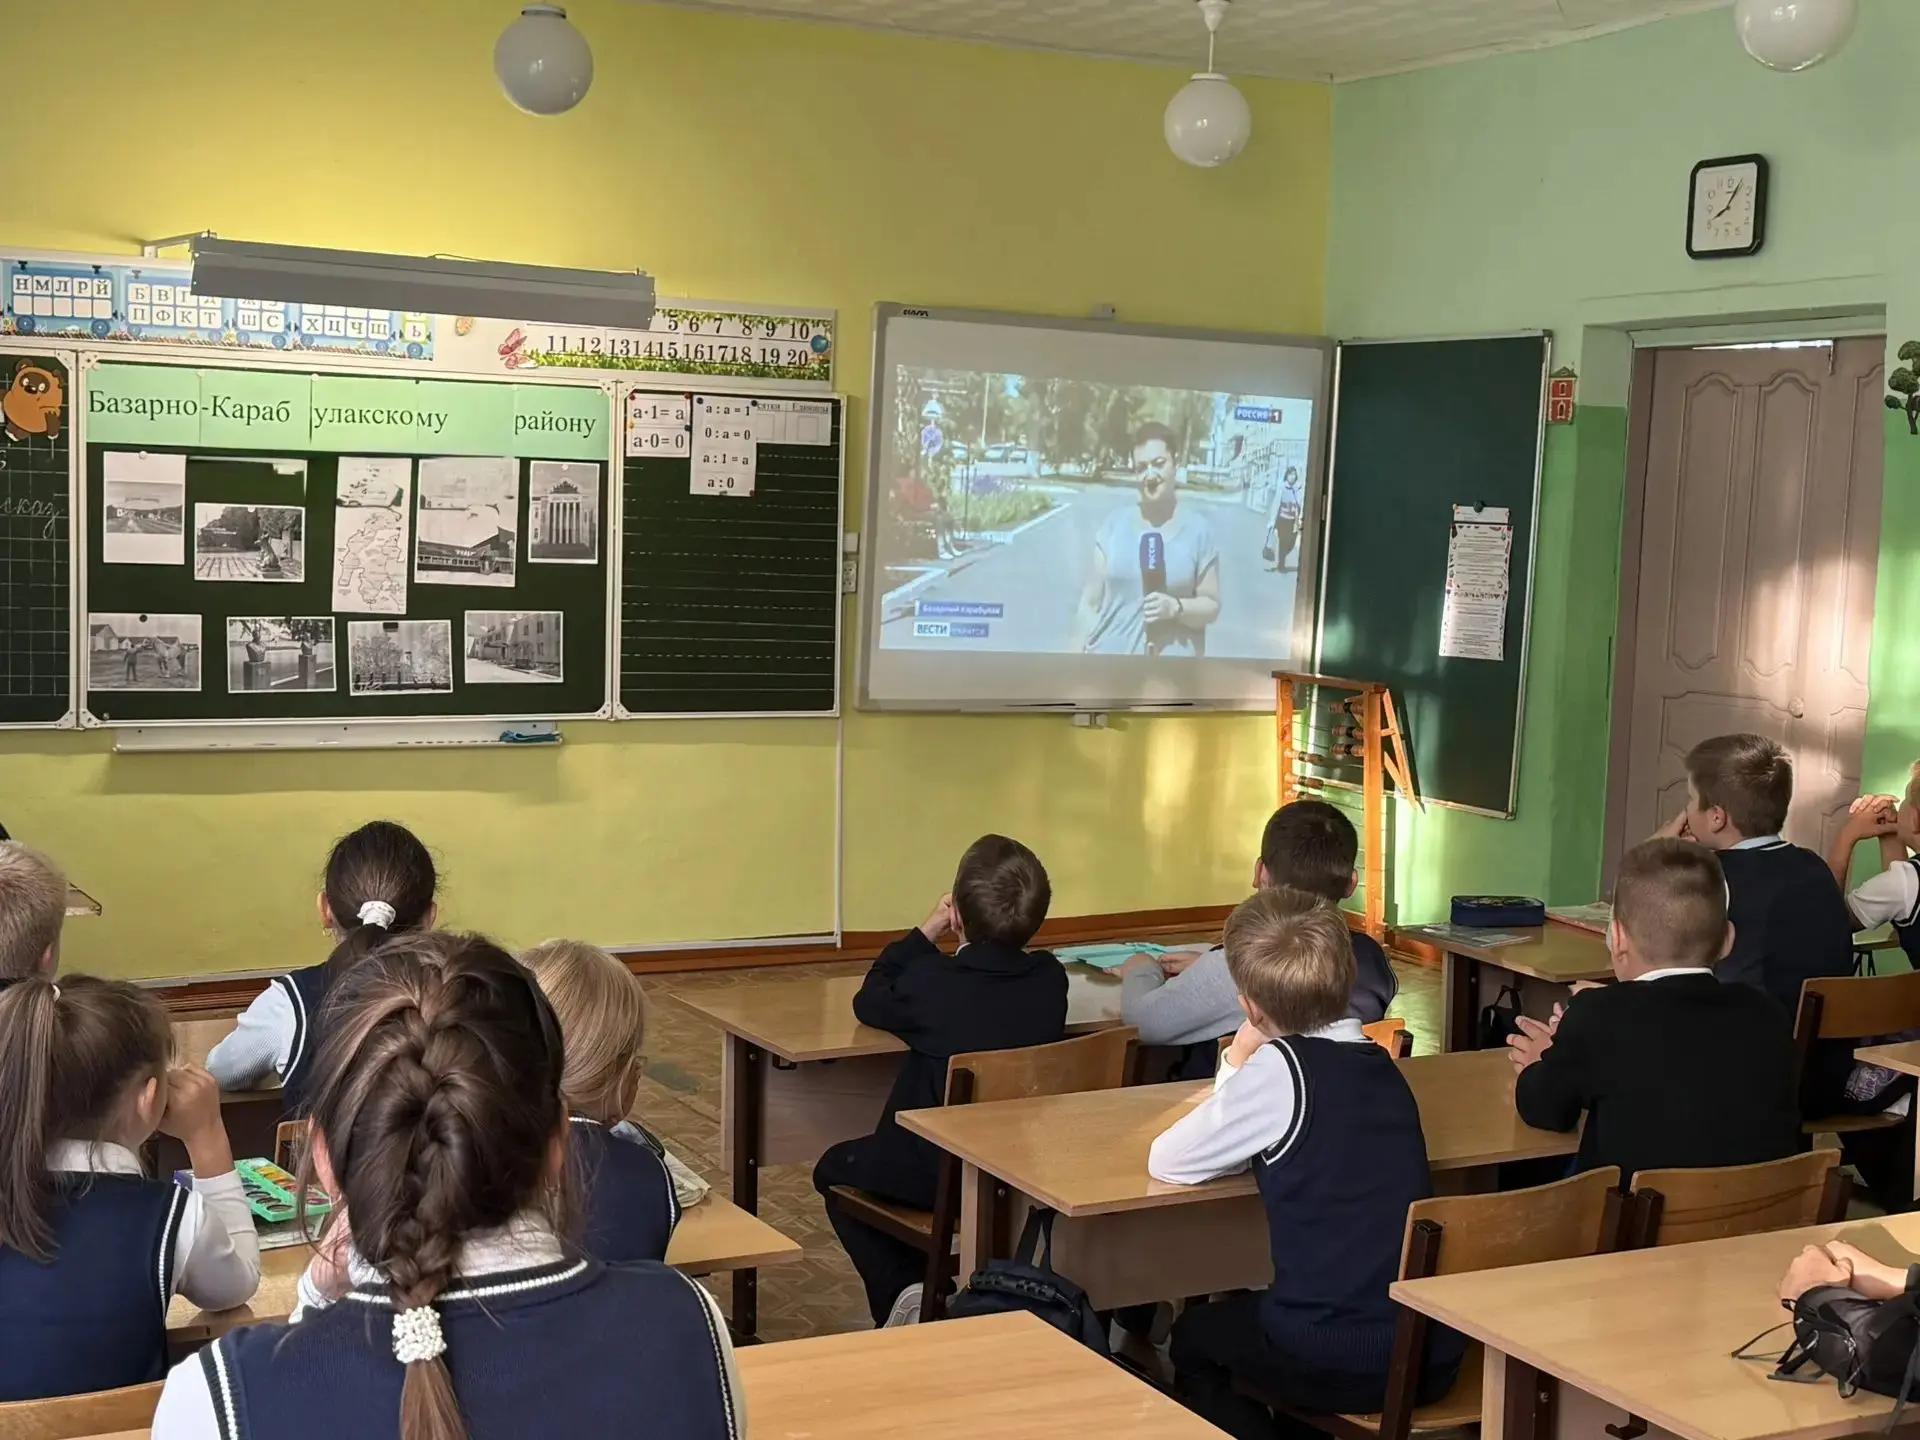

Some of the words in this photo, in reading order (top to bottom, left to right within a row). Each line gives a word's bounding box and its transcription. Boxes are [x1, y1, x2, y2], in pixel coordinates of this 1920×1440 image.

[667, 313, 679, 332] 5
[688, 316, 700, 333] 6
[713, 317, 724, 334] 7
[741, 318, 753, 337] 8
[765, 321, 777, 338] 9
[789, 322, 810, 341] 10
[547, 335, 568, 352] 11
[579, 336, 602, 354] 12
[608, 338, 631, 358] 13
[633, 340, 654, 358] 14
[657, 342, 679, 360] 15
[684, 343, 705, 363] 16
[707, 345, 728, 364] 17
[730, 346, 752, 364] 18
[761, 347, 781, 365] 19
[787, 349, 809, 368] 20
[514, 411, 597, 438] району
[917, 624, 947, 634] ВЕСТИ
